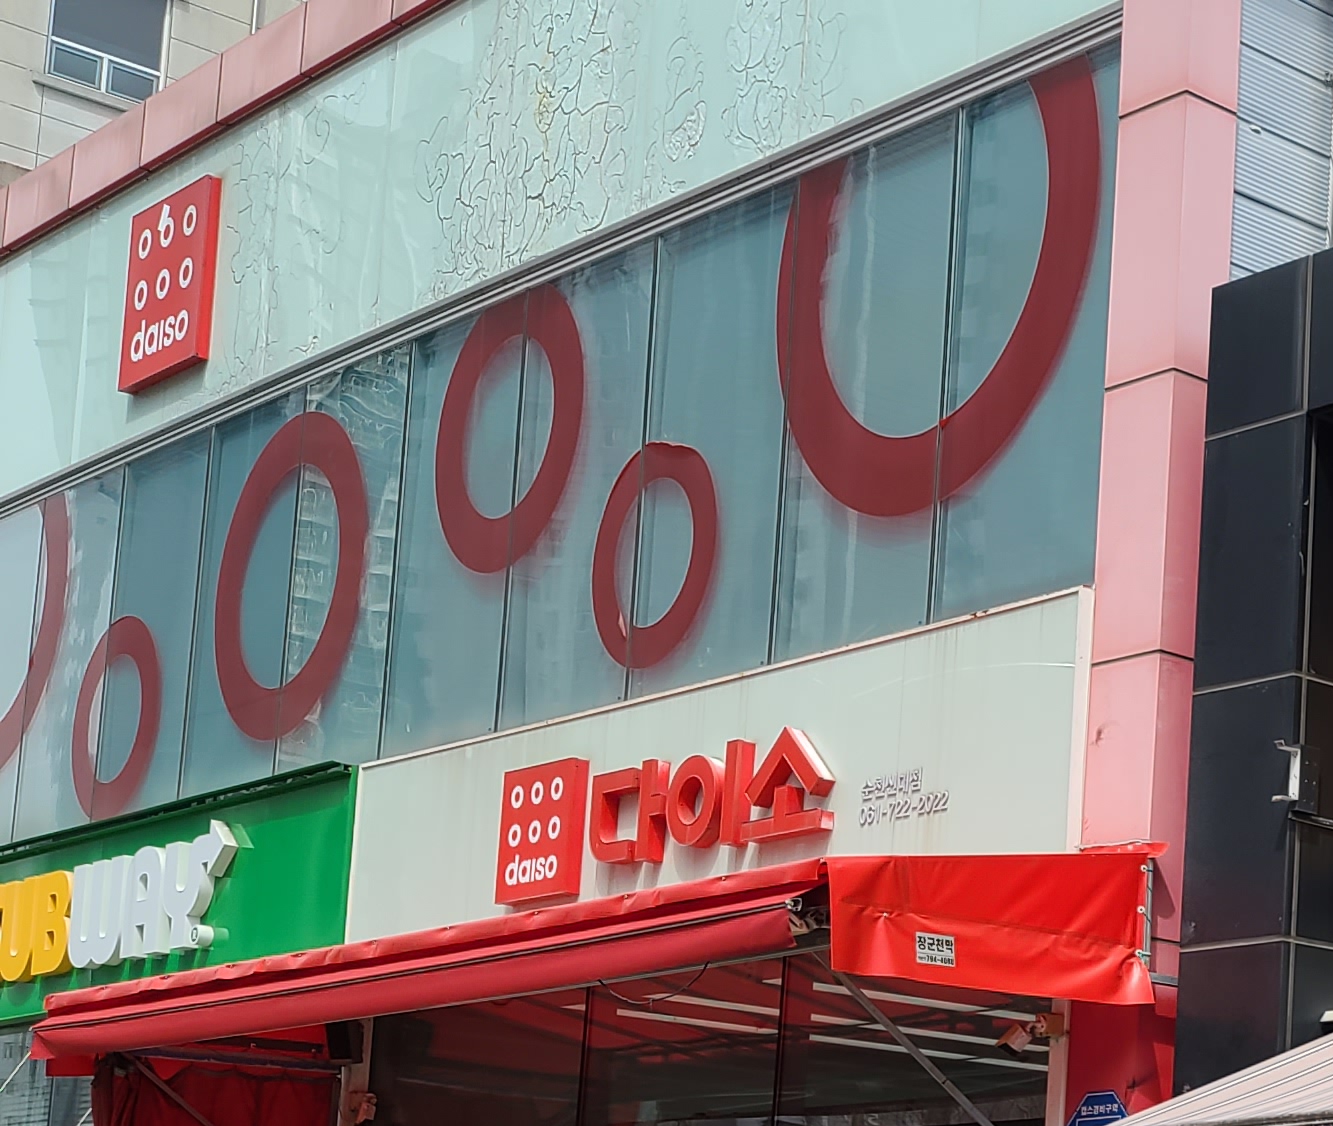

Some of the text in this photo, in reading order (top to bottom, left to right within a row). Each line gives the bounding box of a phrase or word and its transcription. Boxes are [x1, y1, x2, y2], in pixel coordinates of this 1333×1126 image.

[130, 309, 189, 363] daiso
[590, 726, 836, 864] 다이소
[861, 766, 923, 801] 순천신대점
[859, 790, 949, 827] 061-722-2022
[505, 854, 558, 887] daiso
[0, 819, 239, 982] UBWAY
[917, 936, 953, 954] 장군천막
